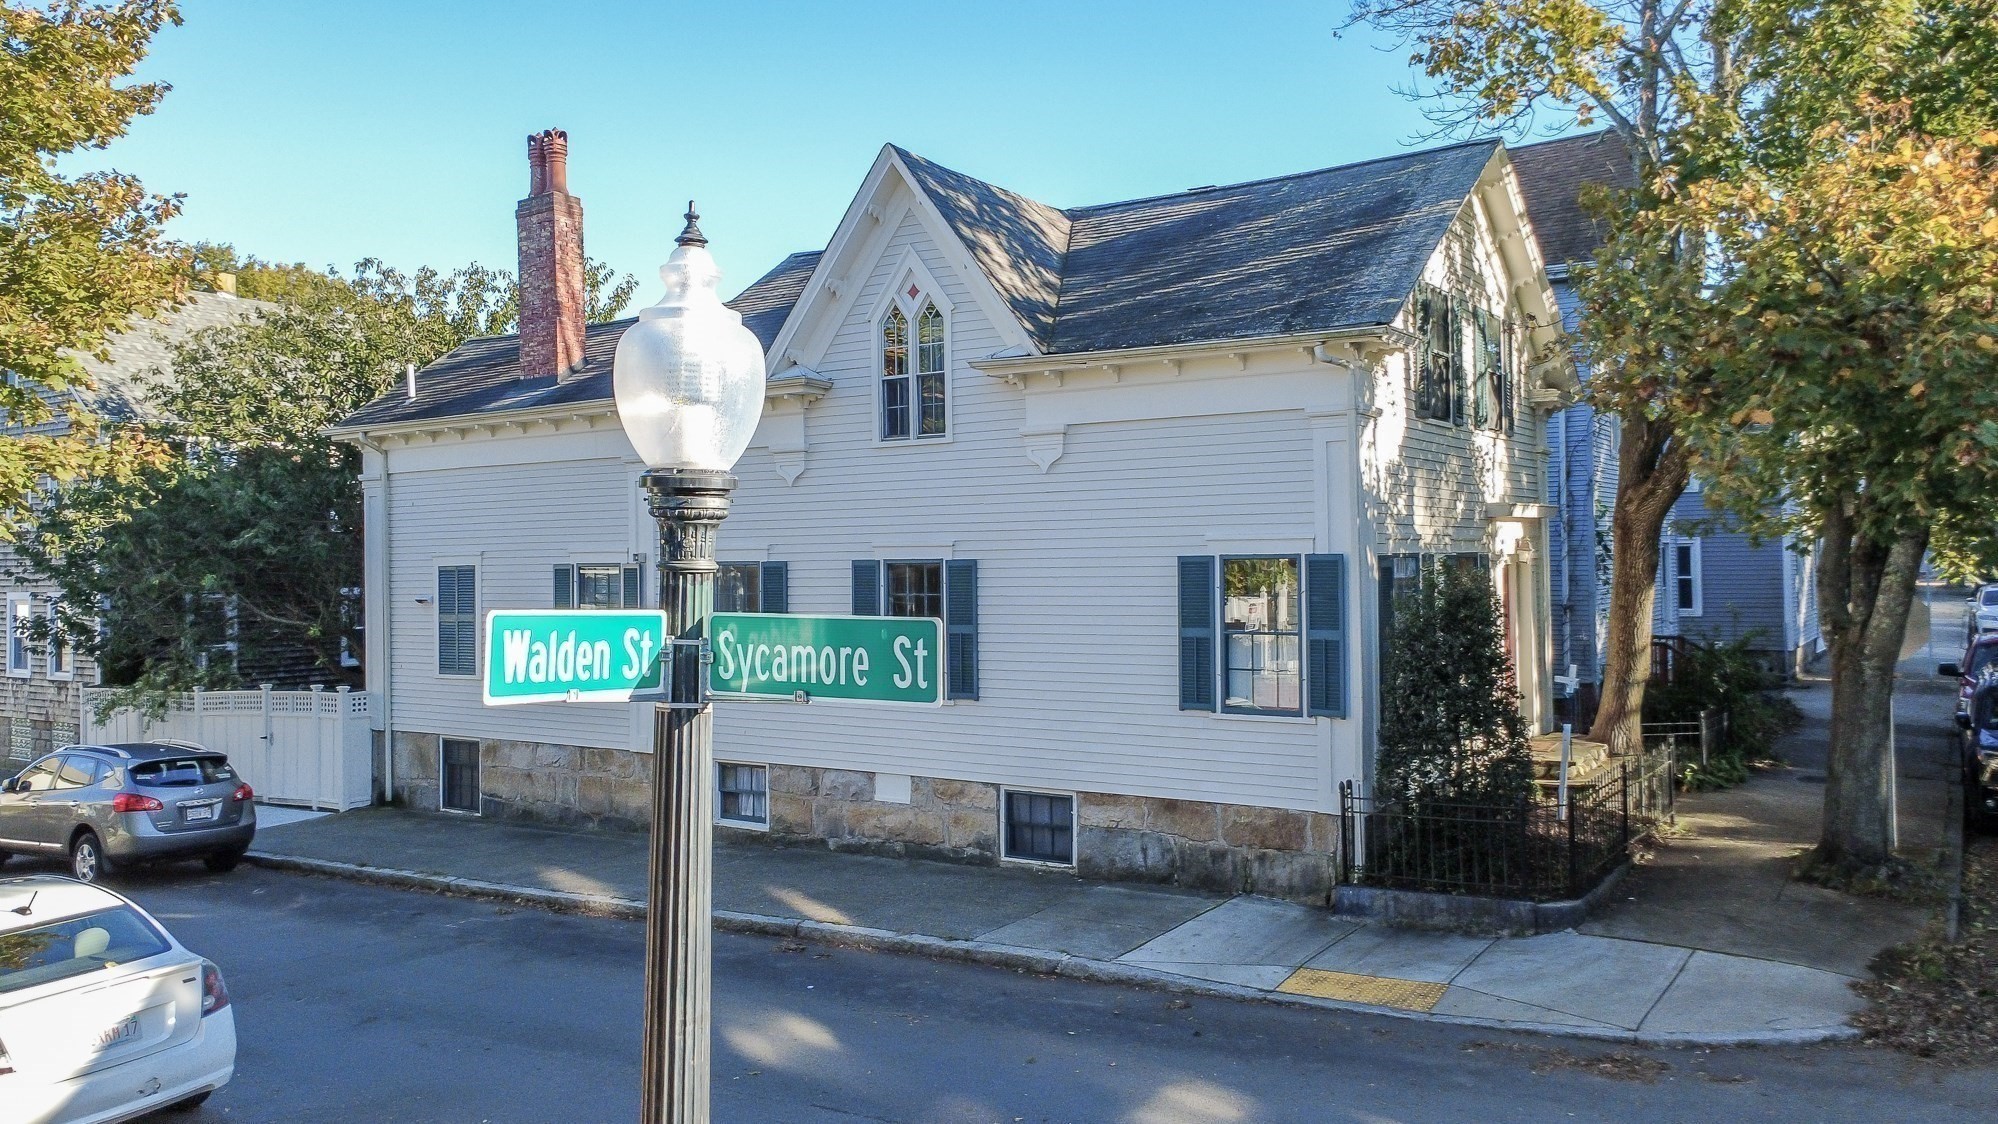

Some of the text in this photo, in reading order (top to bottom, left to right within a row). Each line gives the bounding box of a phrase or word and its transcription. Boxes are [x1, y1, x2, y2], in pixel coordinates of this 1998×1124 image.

[502, 627, 654, 684] Walden St
[718, 630, 928, 692] Sycamore St
